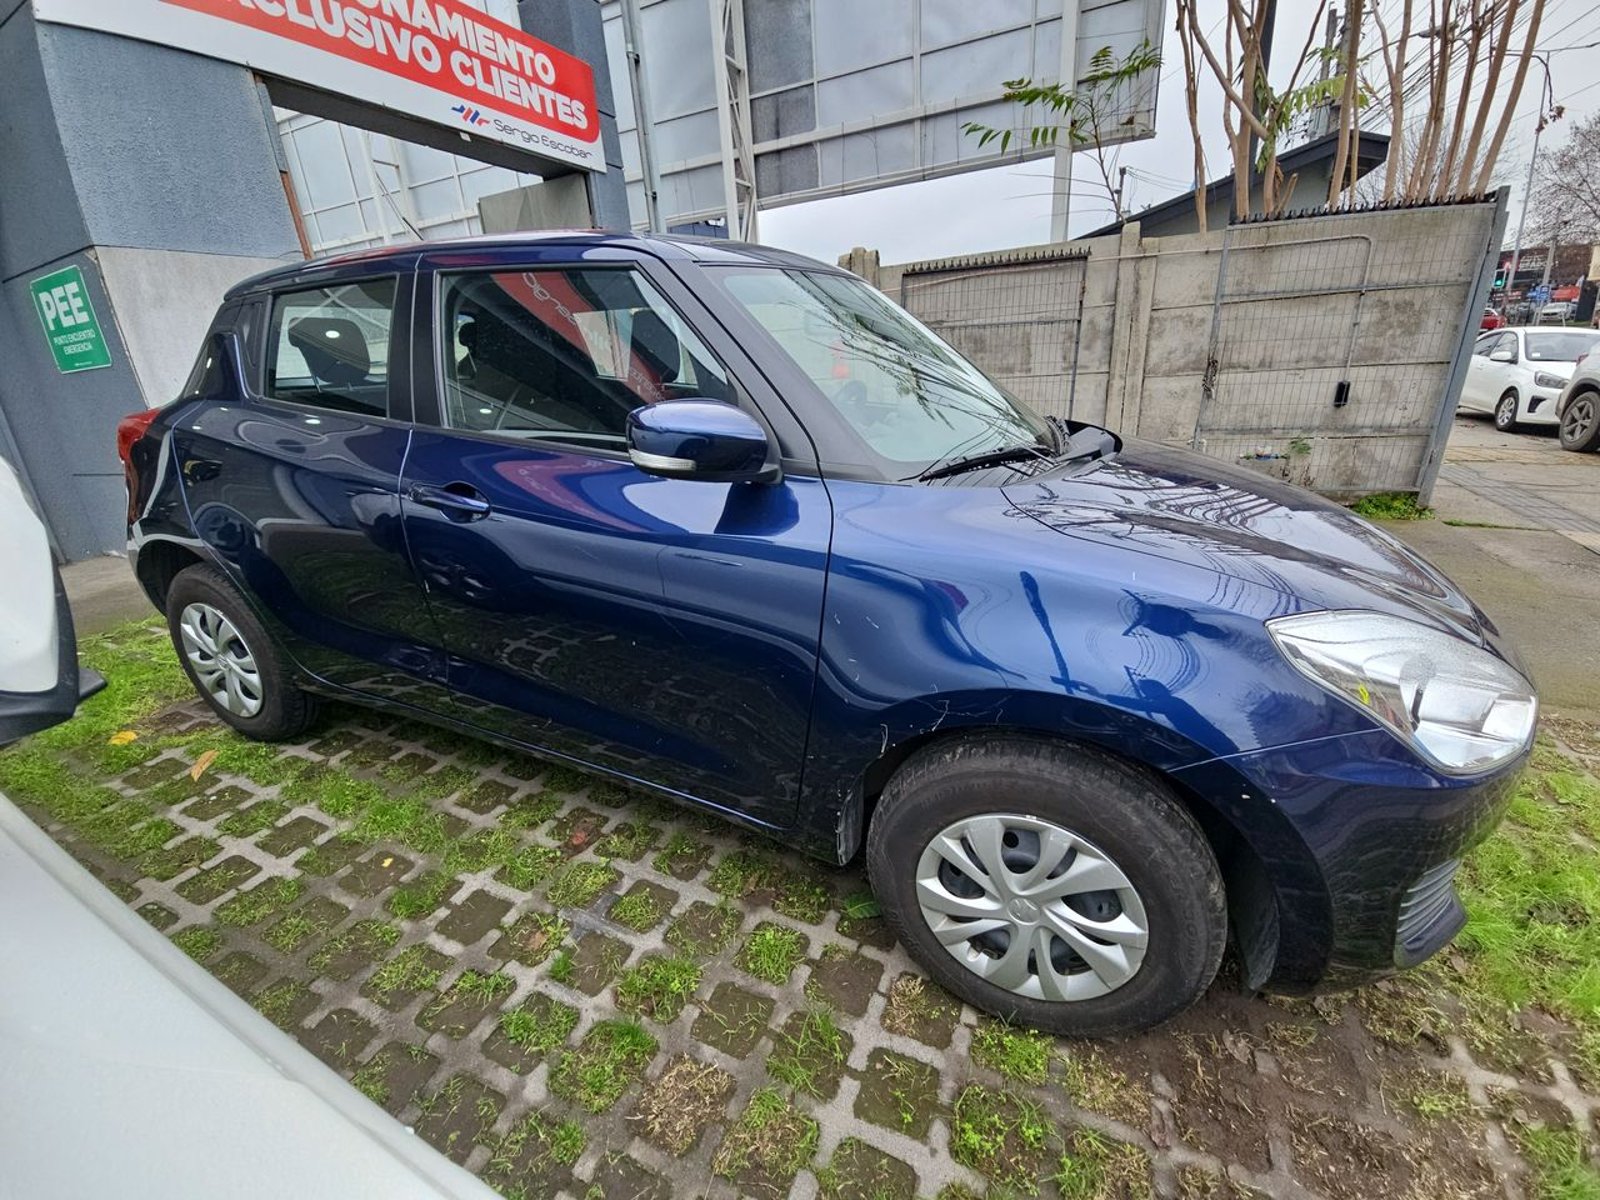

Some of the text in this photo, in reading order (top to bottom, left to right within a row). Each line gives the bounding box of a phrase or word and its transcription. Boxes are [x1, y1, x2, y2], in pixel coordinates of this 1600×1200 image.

[227, 0, 589, 130] LUSIVO CLIENTES
[355, 0, 556, 85] NAMIENTO
[38, 281, 90, 331] PEE
